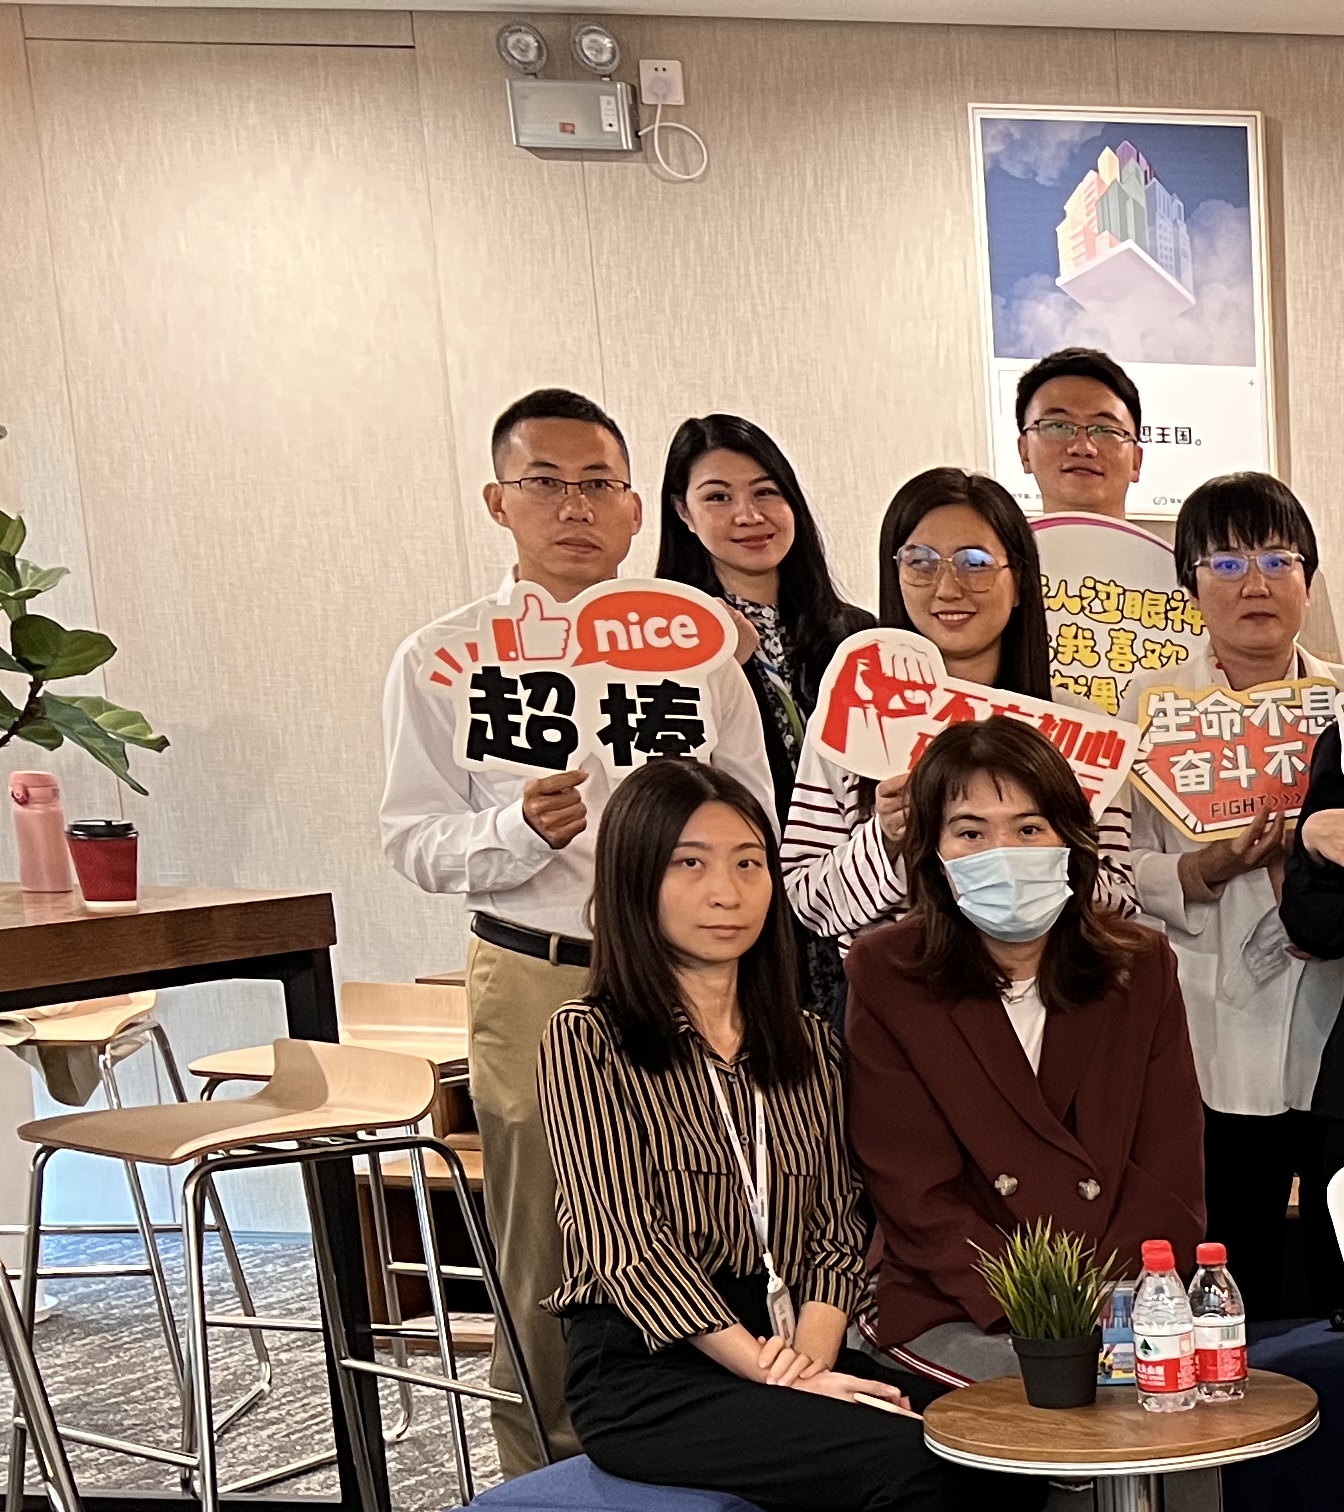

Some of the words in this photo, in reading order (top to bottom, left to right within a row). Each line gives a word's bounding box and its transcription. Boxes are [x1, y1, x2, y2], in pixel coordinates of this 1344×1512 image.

[593, 609, 699, 653] nice
[466, 665, 708, 768] 超棒
[1147, 684, 1339, 745] 生命不息
[1168, 740, 1310, 795] 奋斗不
[1210, 793, 1269, 818] FIGHT
